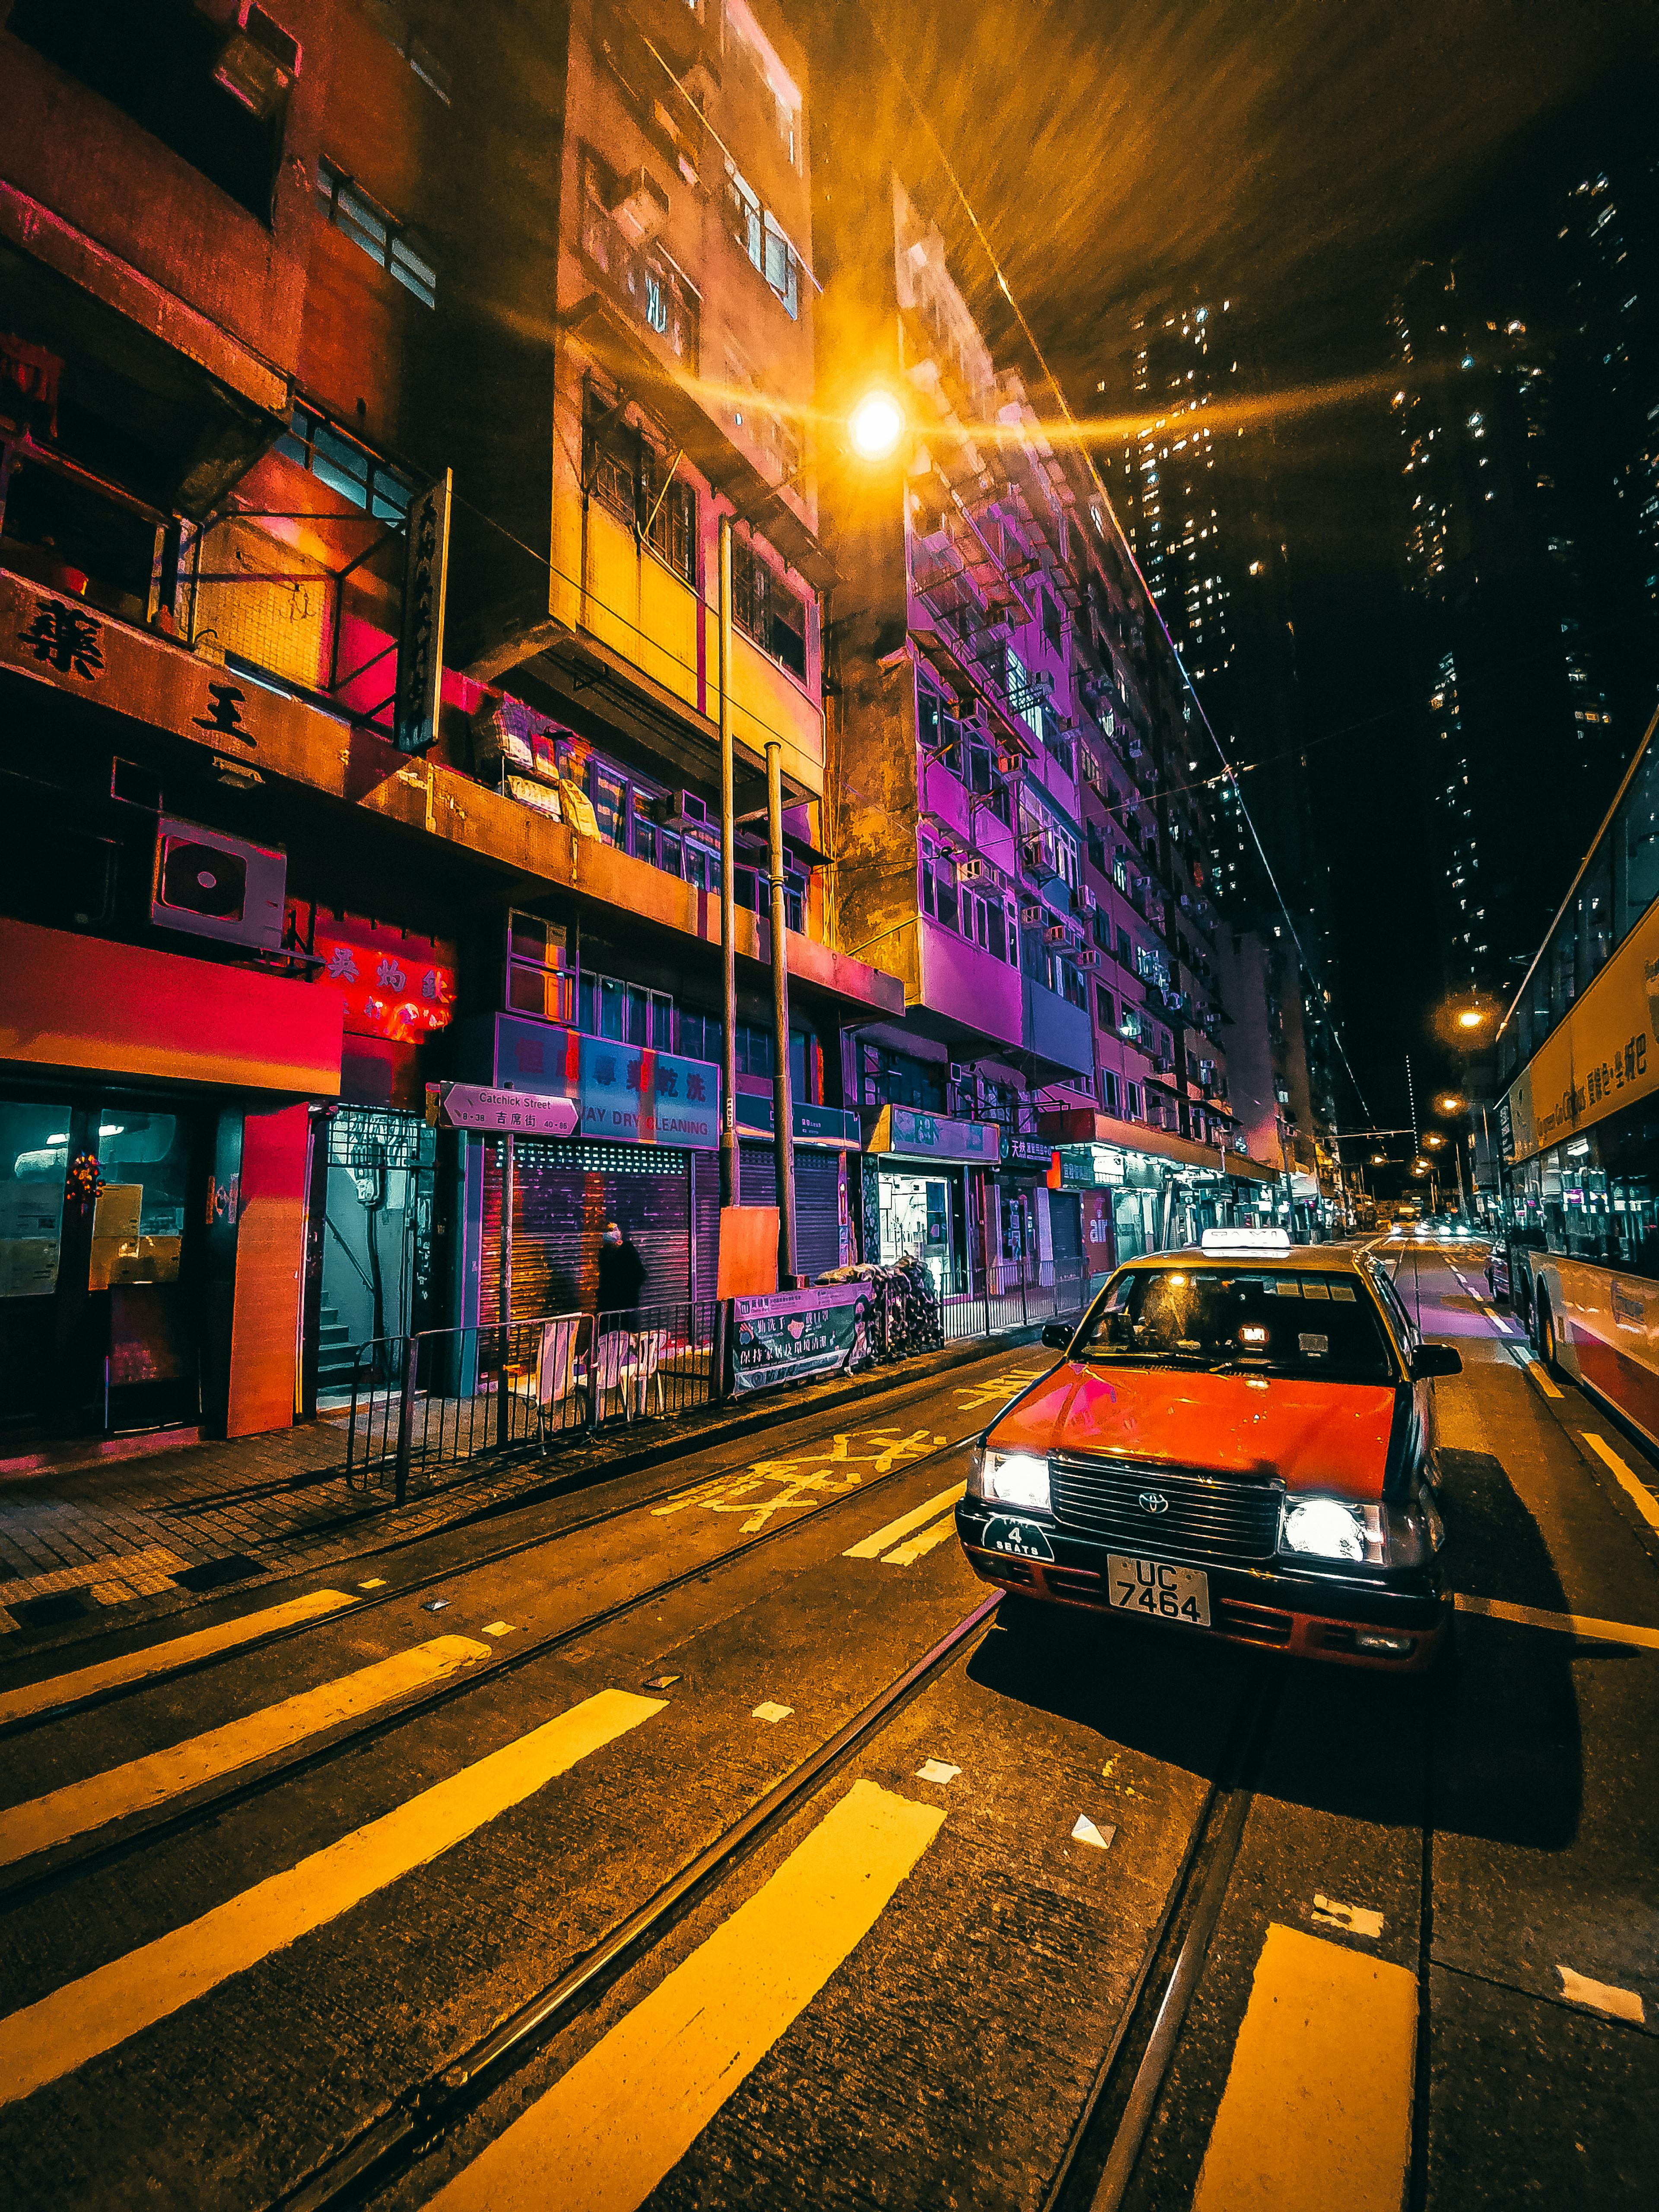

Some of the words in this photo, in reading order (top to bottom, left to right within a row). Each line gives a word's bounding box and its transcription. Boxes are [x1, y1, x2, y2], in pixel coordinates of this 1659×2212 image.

[479, 1092, 520, 1106] Catchick
[524, 1098, 551, 1109] Street
[496, 1111, 537, 1127] 吉席街
[613, 1110, 639, 1127] DRY
[646, 1116, 708, 1135] CLEANING
[1008, 1527, 1022, 1544] 4
[996, 1540, 1039, 1556] SEATS
[1136, 1560, 1177, 1592] UC
[1116, 1580, 1202, 1623] 7464
